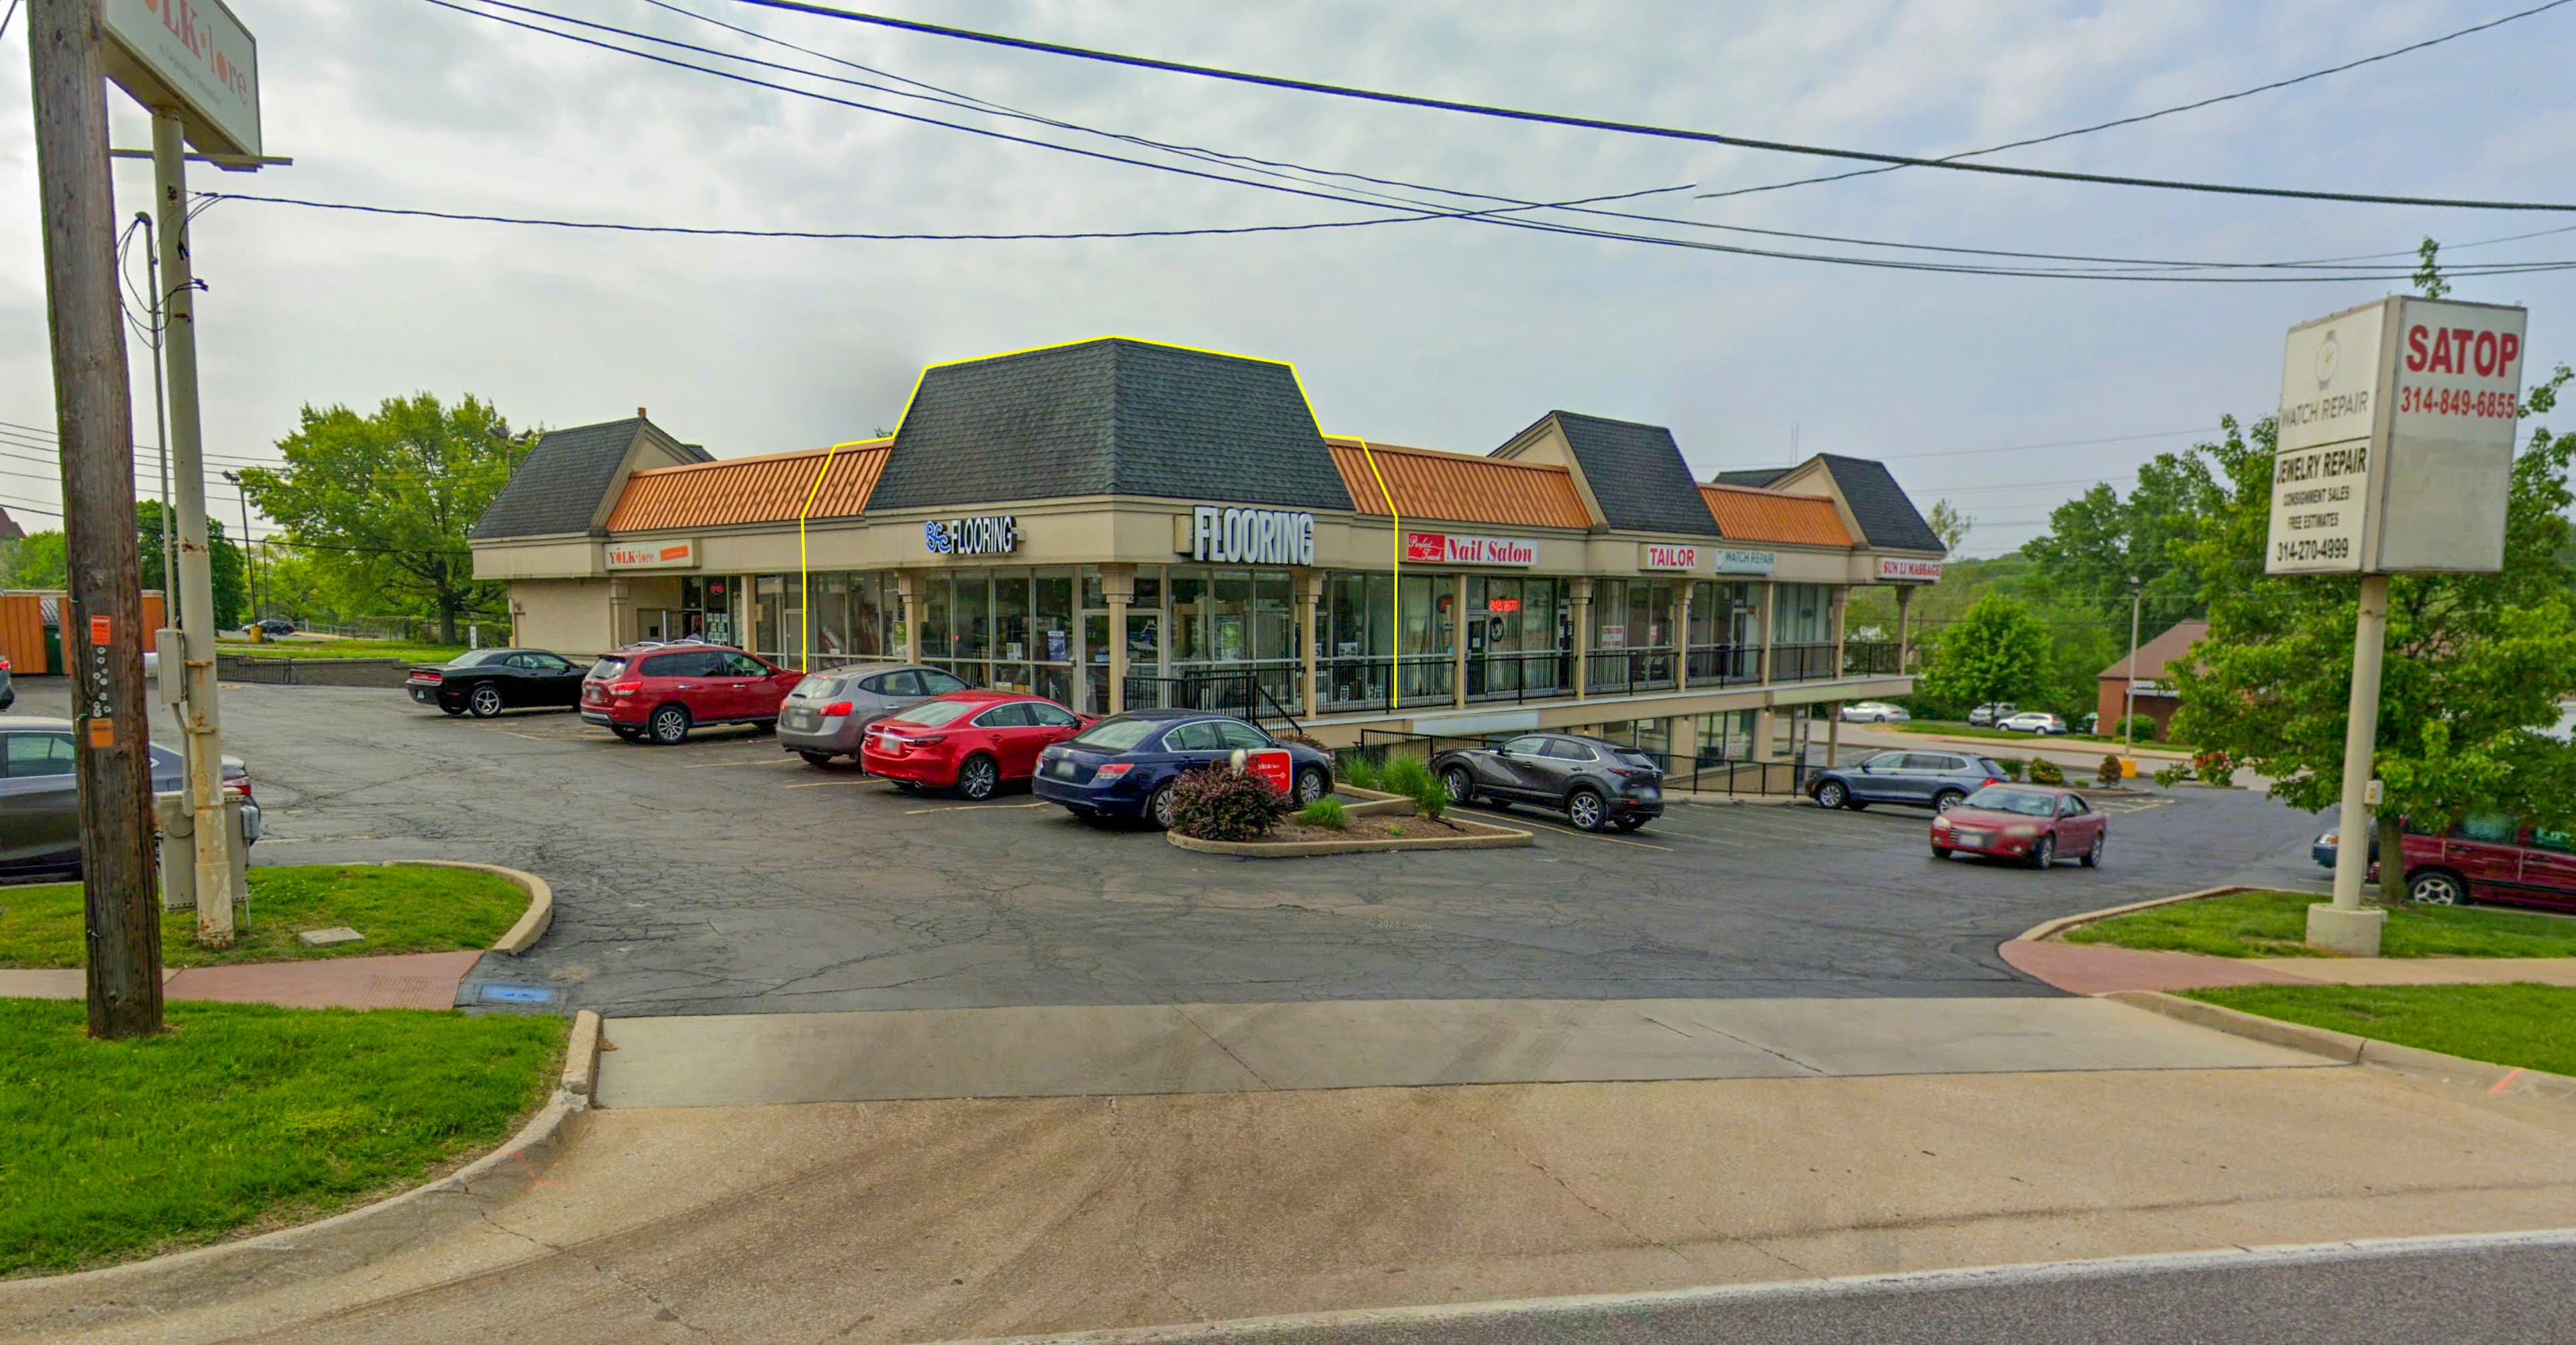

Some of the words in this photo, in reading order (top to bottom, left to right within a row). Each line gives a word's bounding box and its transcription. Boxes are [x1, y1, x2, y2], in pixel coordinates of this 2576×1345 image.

[2406, 324, 2519, 378] SATOP
[2282, 401, 2318, 428] WATCH
[2321, 391, 2369, 421] REPAIR
[2400, 386, 2516, 419] 314-849-6855
[2276, 453, 2322, 484] JEWELRY
[2322, 447, 2367, 478] REPAIR
[2283, 488, 2327, 508] CONSIGNMENT
[2327, 485, 2350, 502] SALES
[2288, 515, 2303, 531] FREE
[2303, 512, 2340, 530] ESTIMATES
[951, 515, 1013, 555] FLOORING
[1193, 504, 1316, 567] FLOORING
[1409, 535, 1434, 550] Perfect
[1421, 546, 1442, 561] Touch
[1446, 538, 1483, 562] Nail
[1487, 540, 1533, 563] Salon
[1650, 547, 1695, 568] TAILOR
[1725, 551, 1750, 563] WATCH
[1750, 552, 1776, 566] REPAIR
[2277, 538, 2349, 562] 314-270-4999
[1882, 560, 1898, 575] SUN
[1908, 562, 1941, 577] MASSAGE
